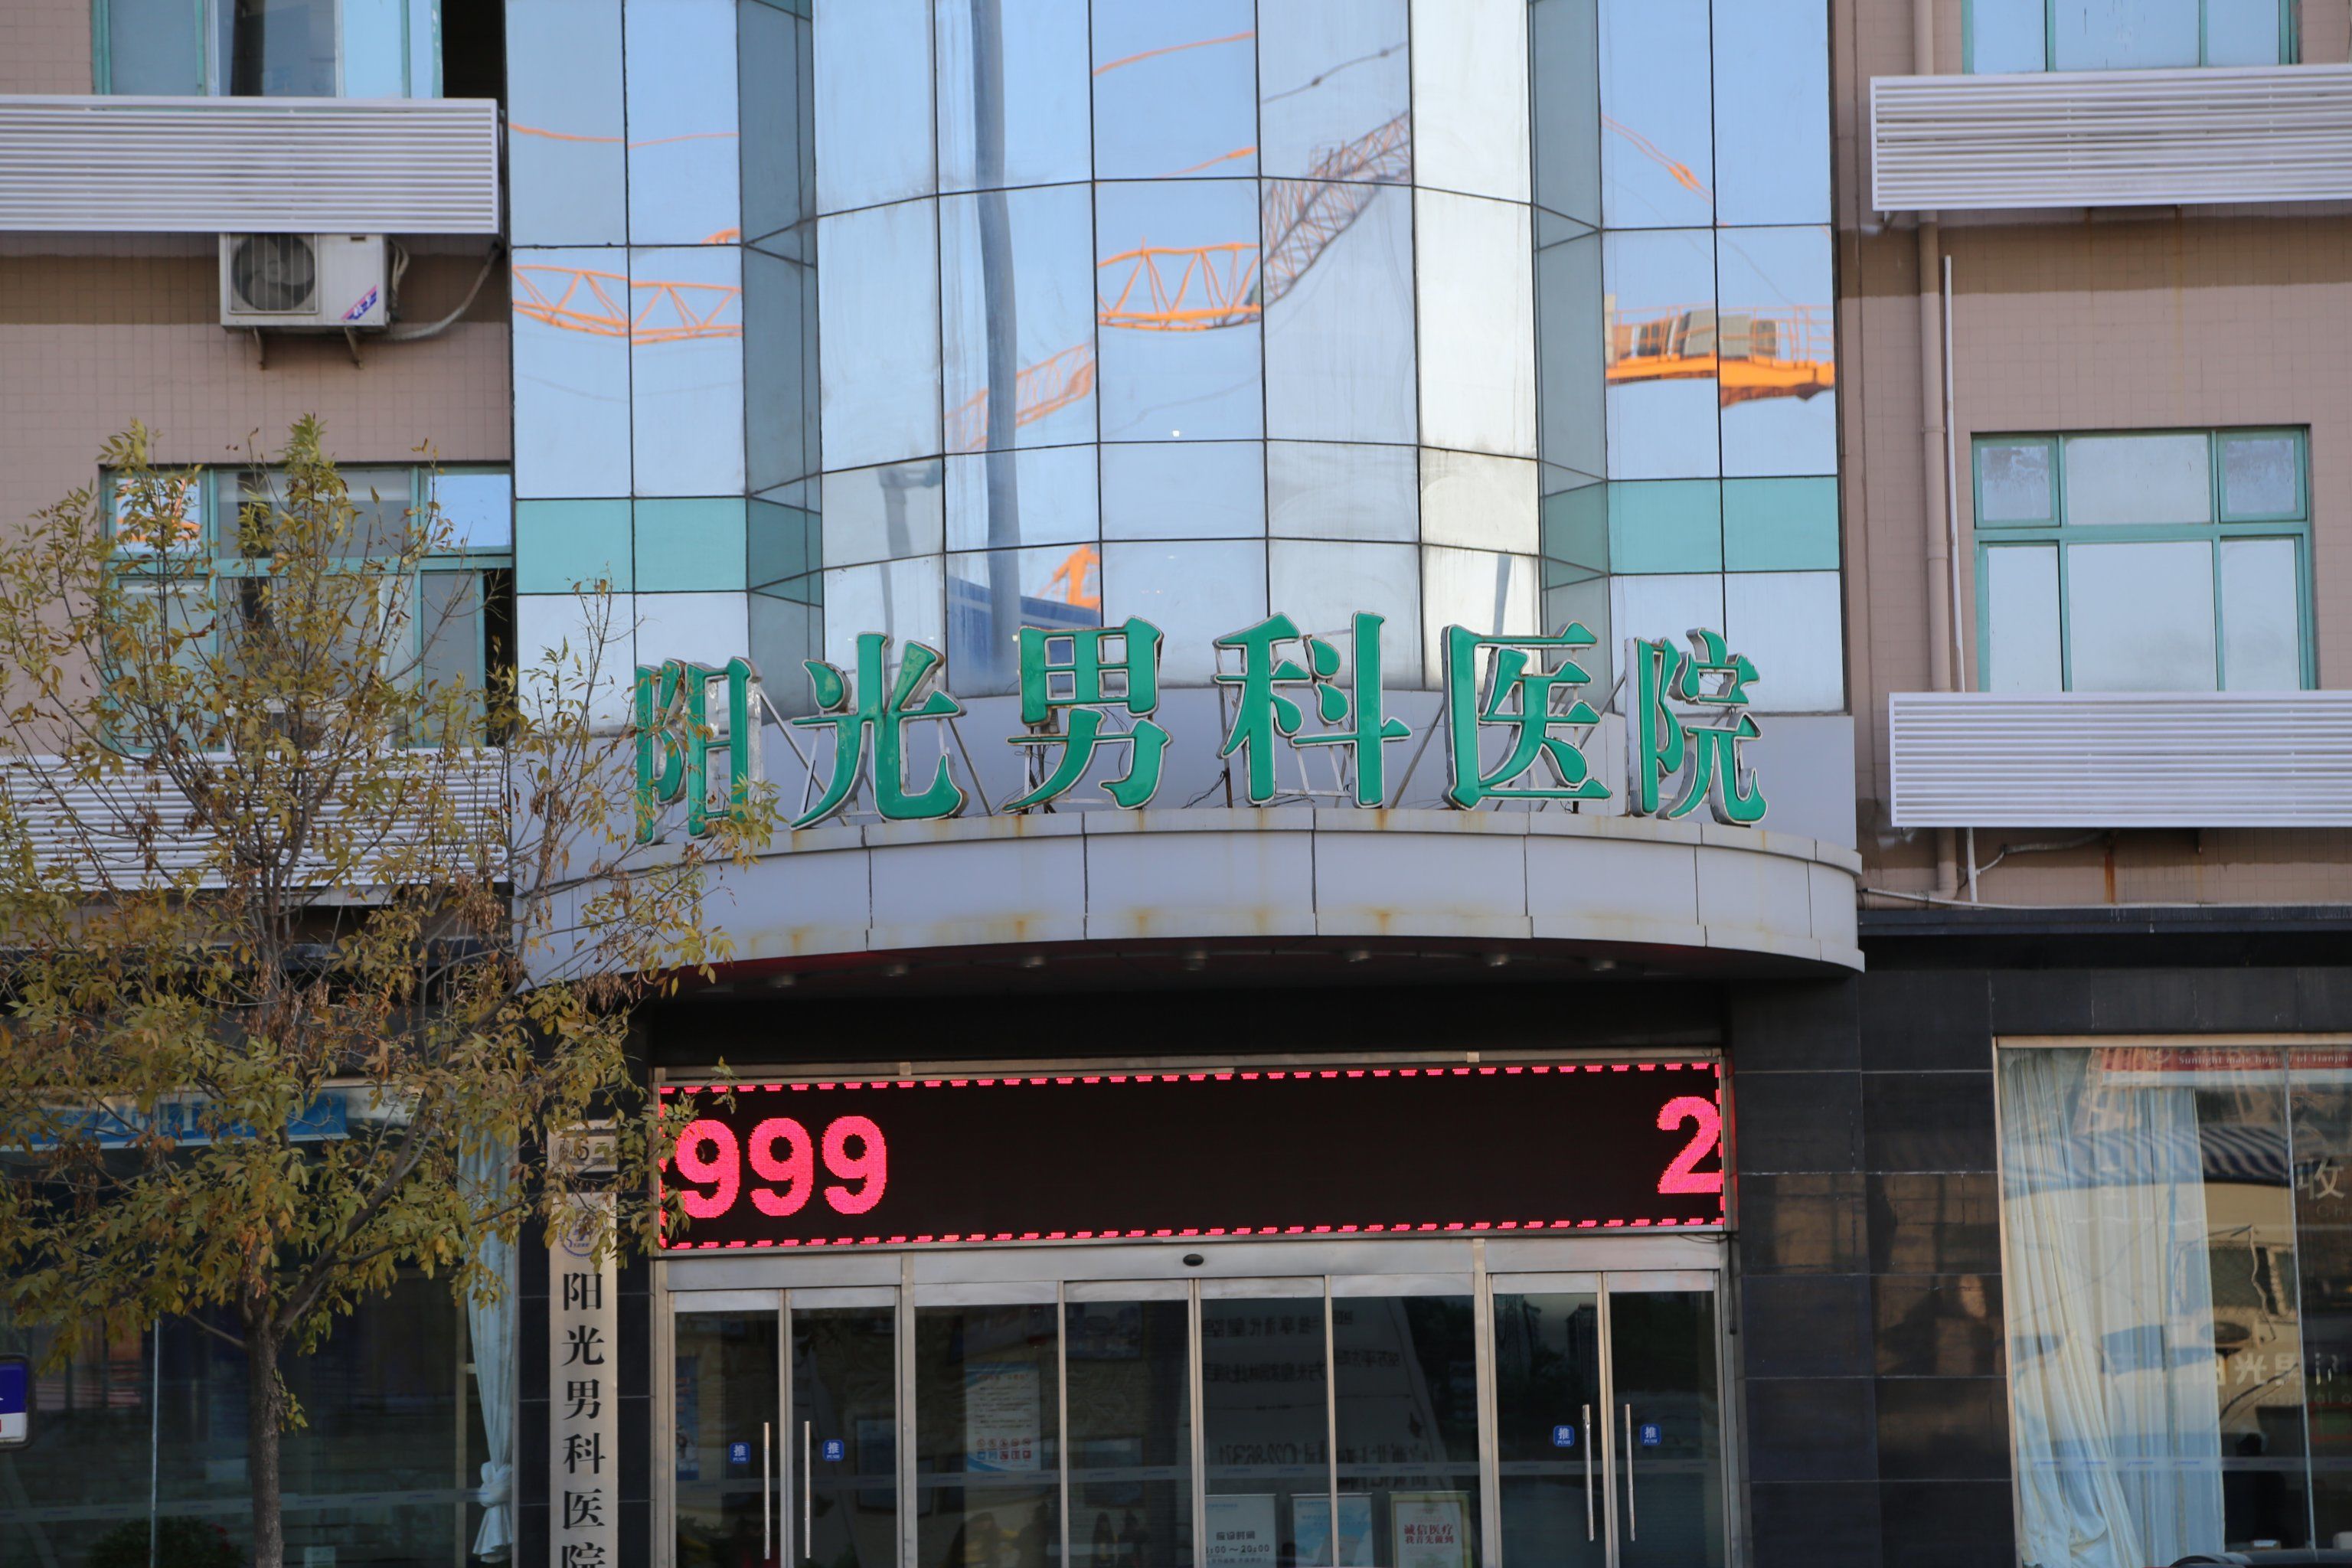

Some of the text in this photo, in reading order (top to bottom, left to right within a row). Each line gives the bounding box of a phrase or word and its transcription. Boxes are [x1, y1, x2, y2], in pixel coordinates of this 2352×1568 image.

[634, 610, 1769, 845] 阳光男科医院
[1656, 1096, 1721, 1194] 2
[560, 1270, 606, 1568] 阳光男科医院
[1558, 1427, 1570, 1439] 推
[1645, 1426, 1657, 1439] 推
[733, 1444, 746, 1457] 推
[827, 1442, 840, 1455] 推
